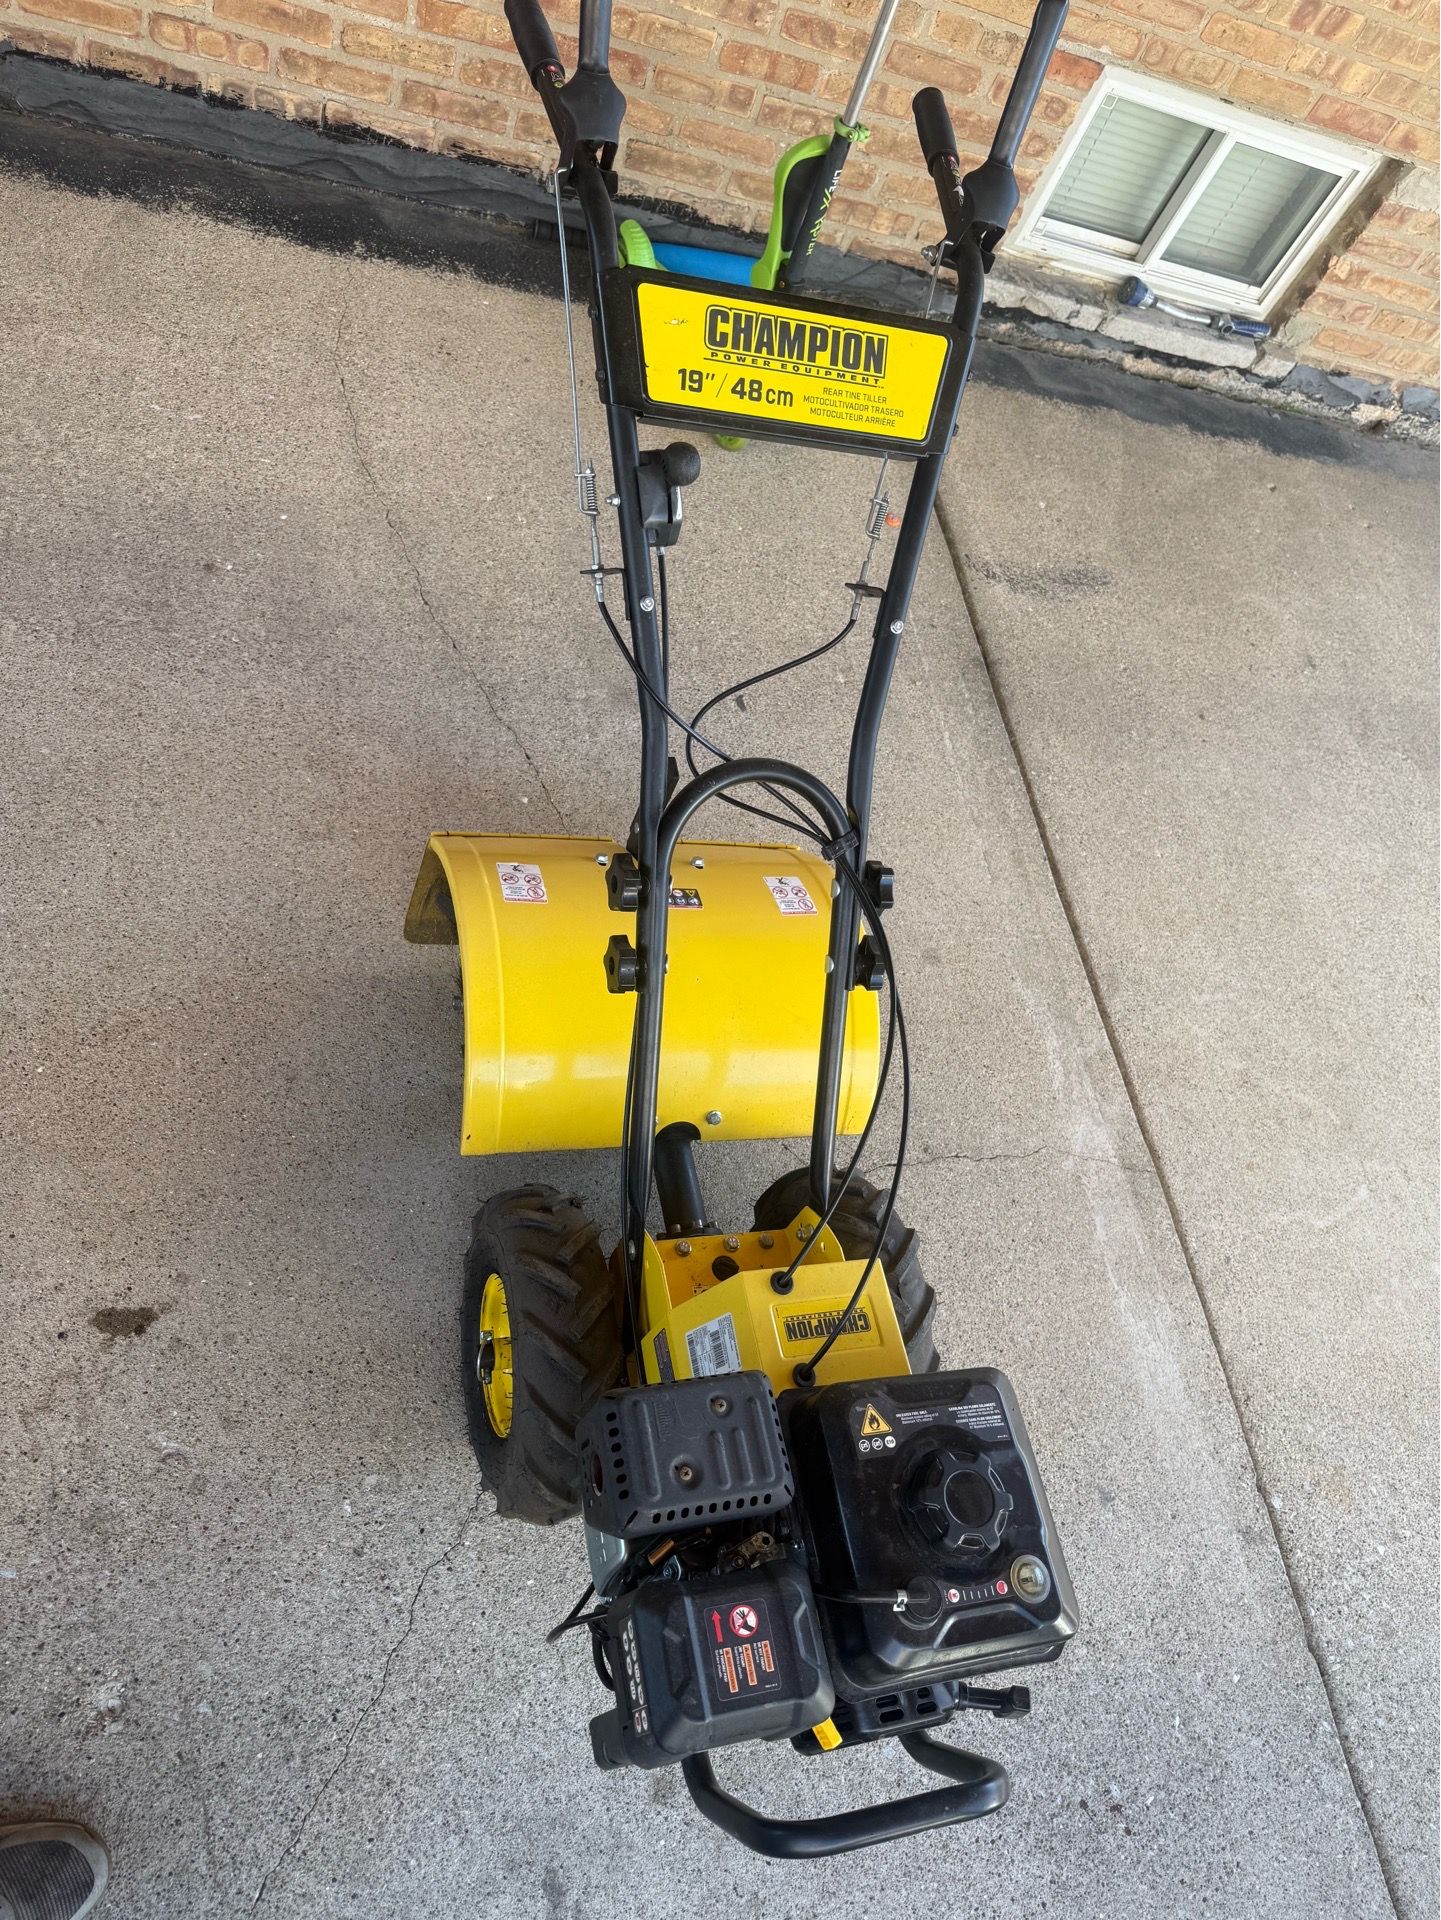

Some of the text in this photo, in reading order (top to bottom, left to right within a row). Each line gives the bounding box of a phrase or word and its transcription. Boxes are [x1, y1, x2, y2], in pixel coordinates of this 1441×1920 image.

[705, 305, 887, 378] CHAMPION
[711, 352, 880, 385] POWER EQUIPMENT
[803, 395, 904, 418] MOTOCULTIVADOR TRASERO
[823, 387, 887, 404] REAR TINE TILLER
[810, 407, 863, 422] MOTOCULTEUR
